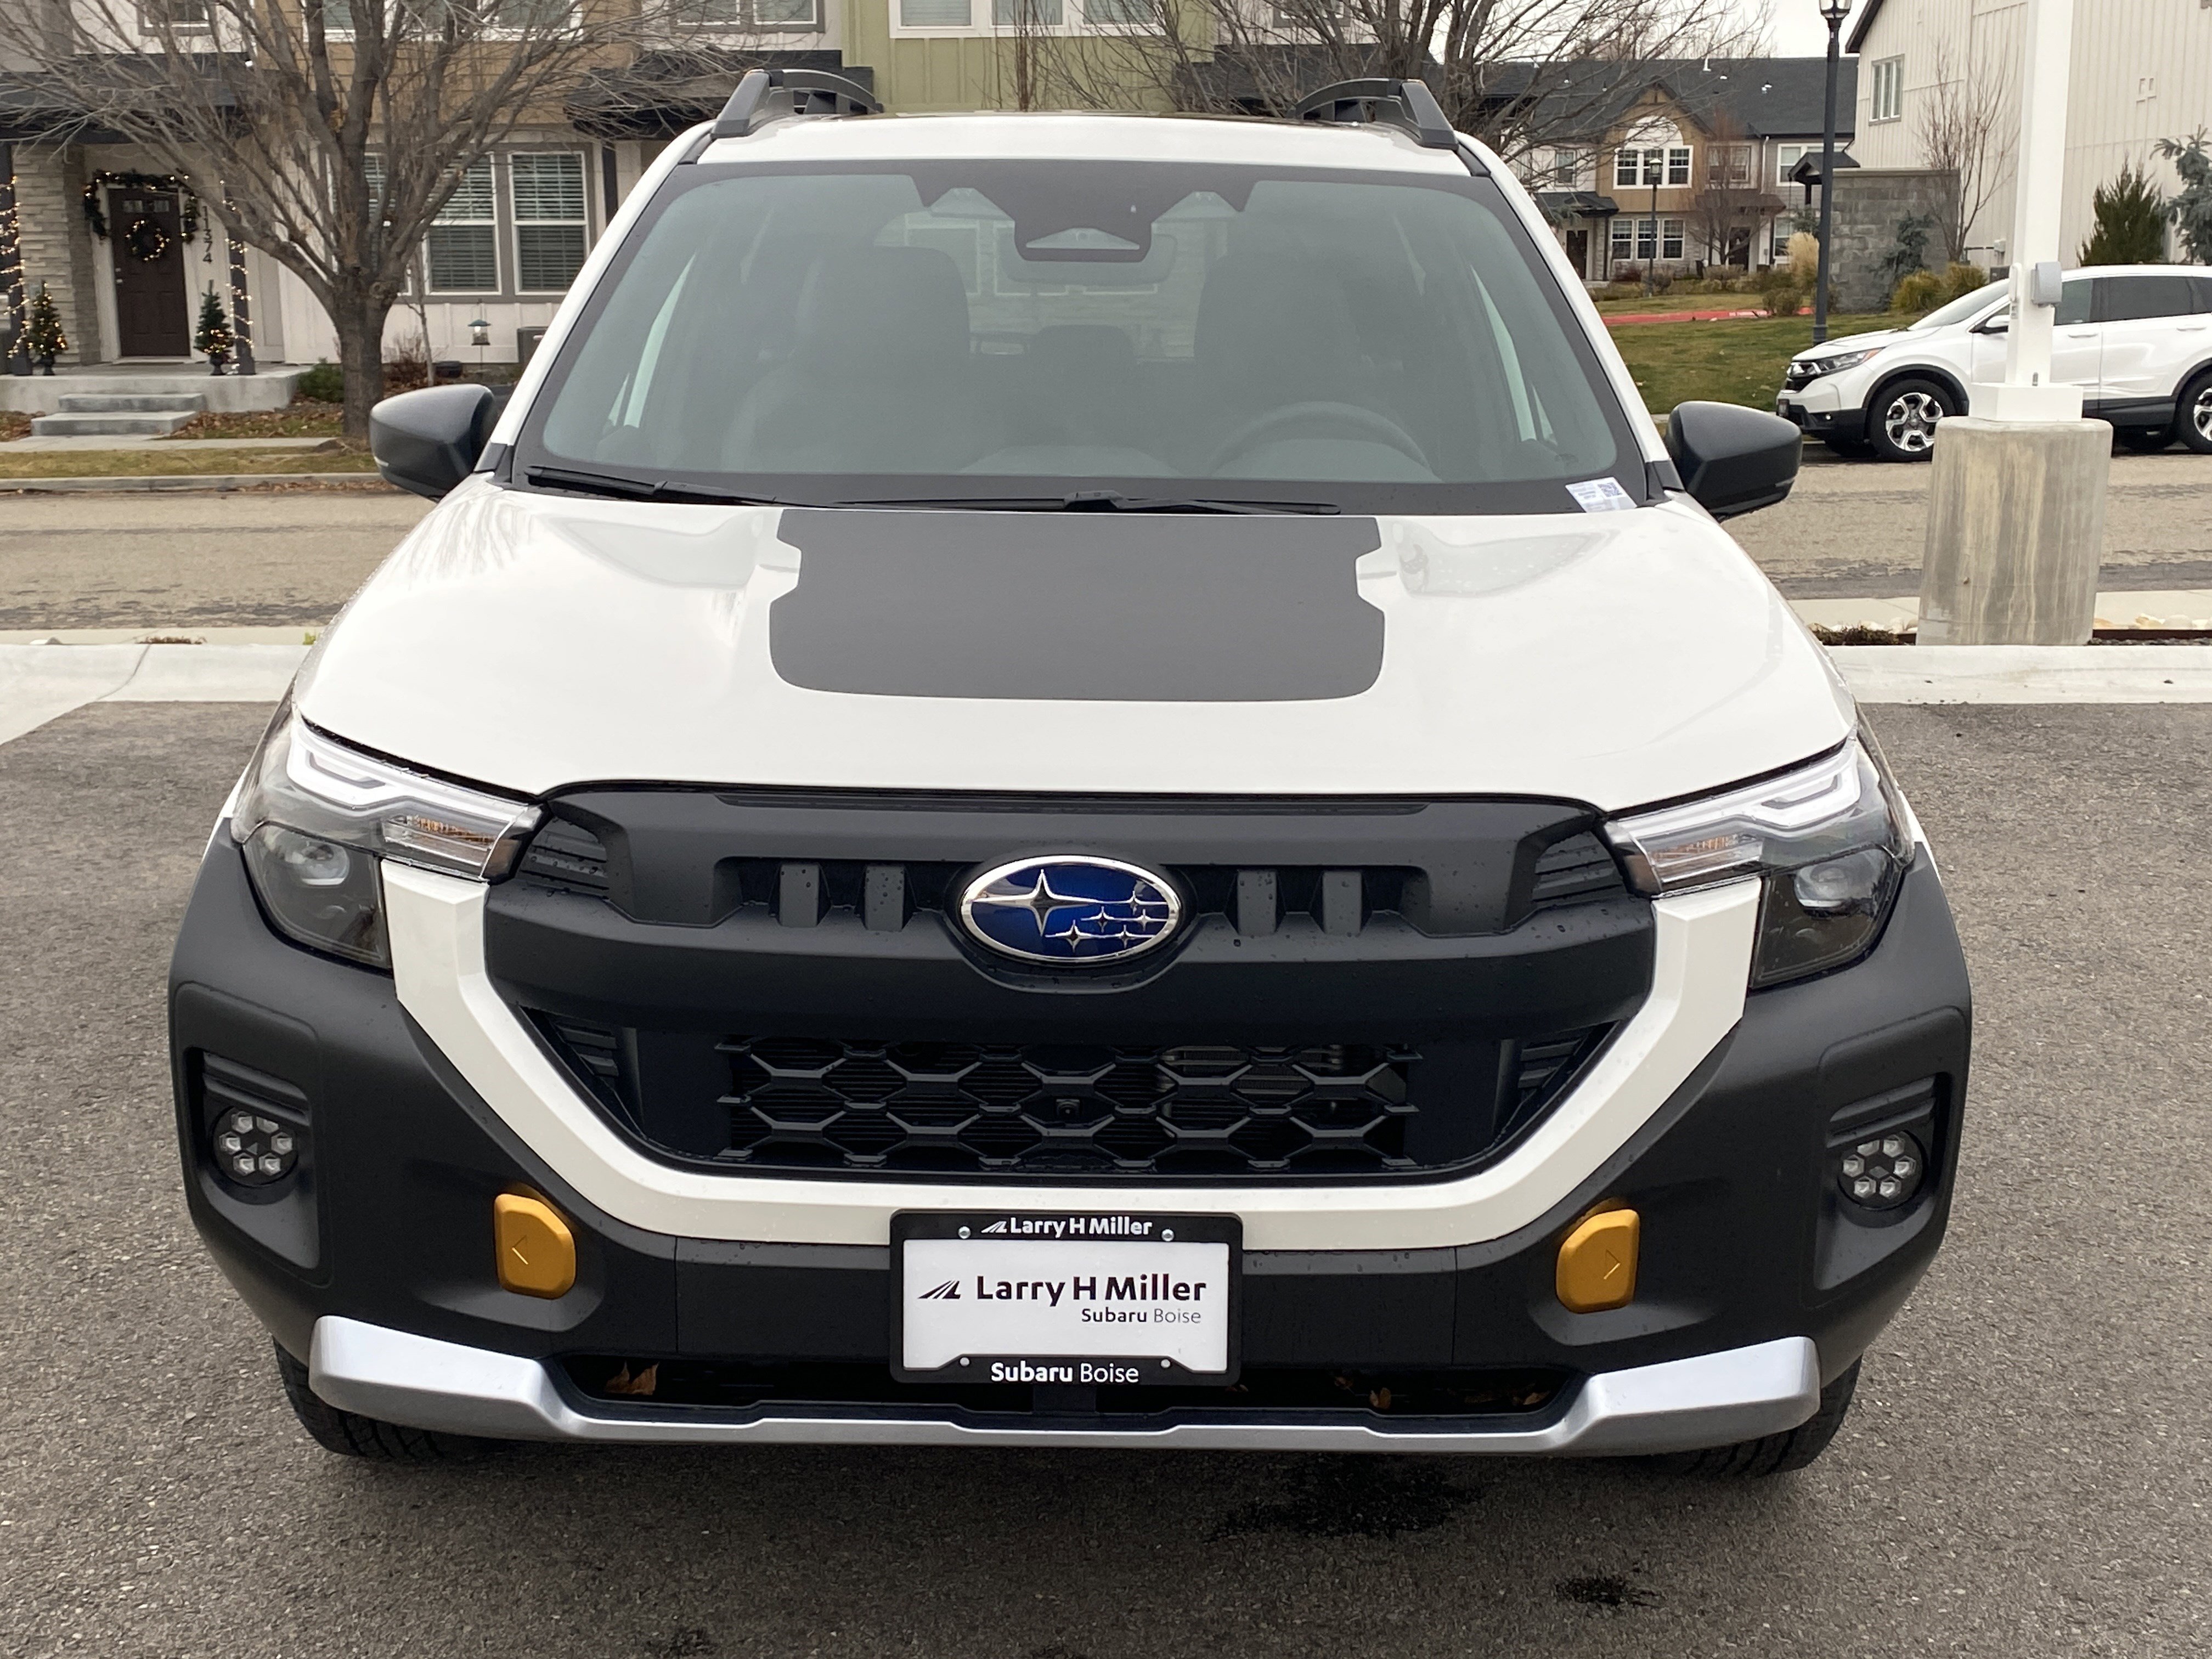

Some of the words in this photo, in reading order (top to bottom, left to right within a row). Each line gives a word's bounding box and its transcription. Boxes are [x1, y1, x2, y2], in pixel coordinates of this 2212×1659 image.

[202, 206, 213, 263] 11374
[1011, 1217, 1066, 1238] Larry
[1069, 1217, 1086, 1234] H
[1088, 1216, 1153, 1235] Miller
[977, 1276, 1065, 1307] Larry
[1073, 1276, 1097, 1300] H
[1104, 1273, 1207, 1301] Miller
[1081, 1306, 1147, 1323] Subaru
[1154, 1307, 1202, 1324] Boise
[991, 1360, 1073, 1383] Subaru
[1080, 1362, 1139, 1384] Boise
